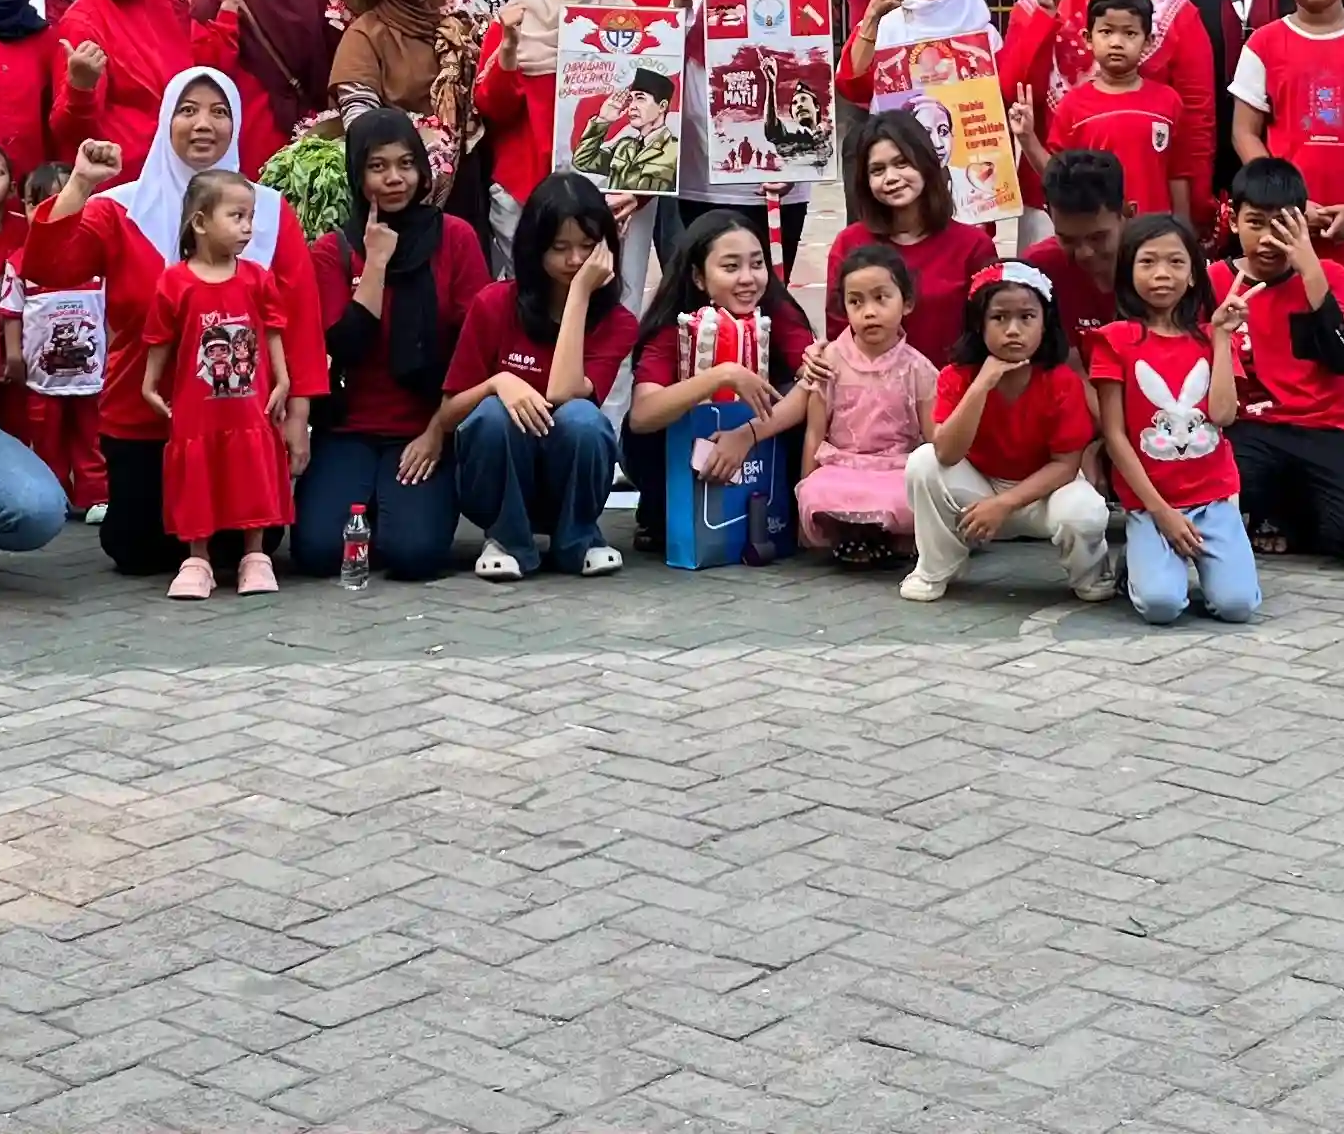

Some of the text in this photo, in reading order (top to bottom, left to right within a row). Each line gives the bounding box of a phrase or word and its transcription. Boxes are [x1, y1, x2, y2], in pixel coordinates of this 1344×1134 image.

[723, 84, 758, 107] MATI!
[523, 355, 536, 365] 09
[743, 460, 764, 475] BRI
